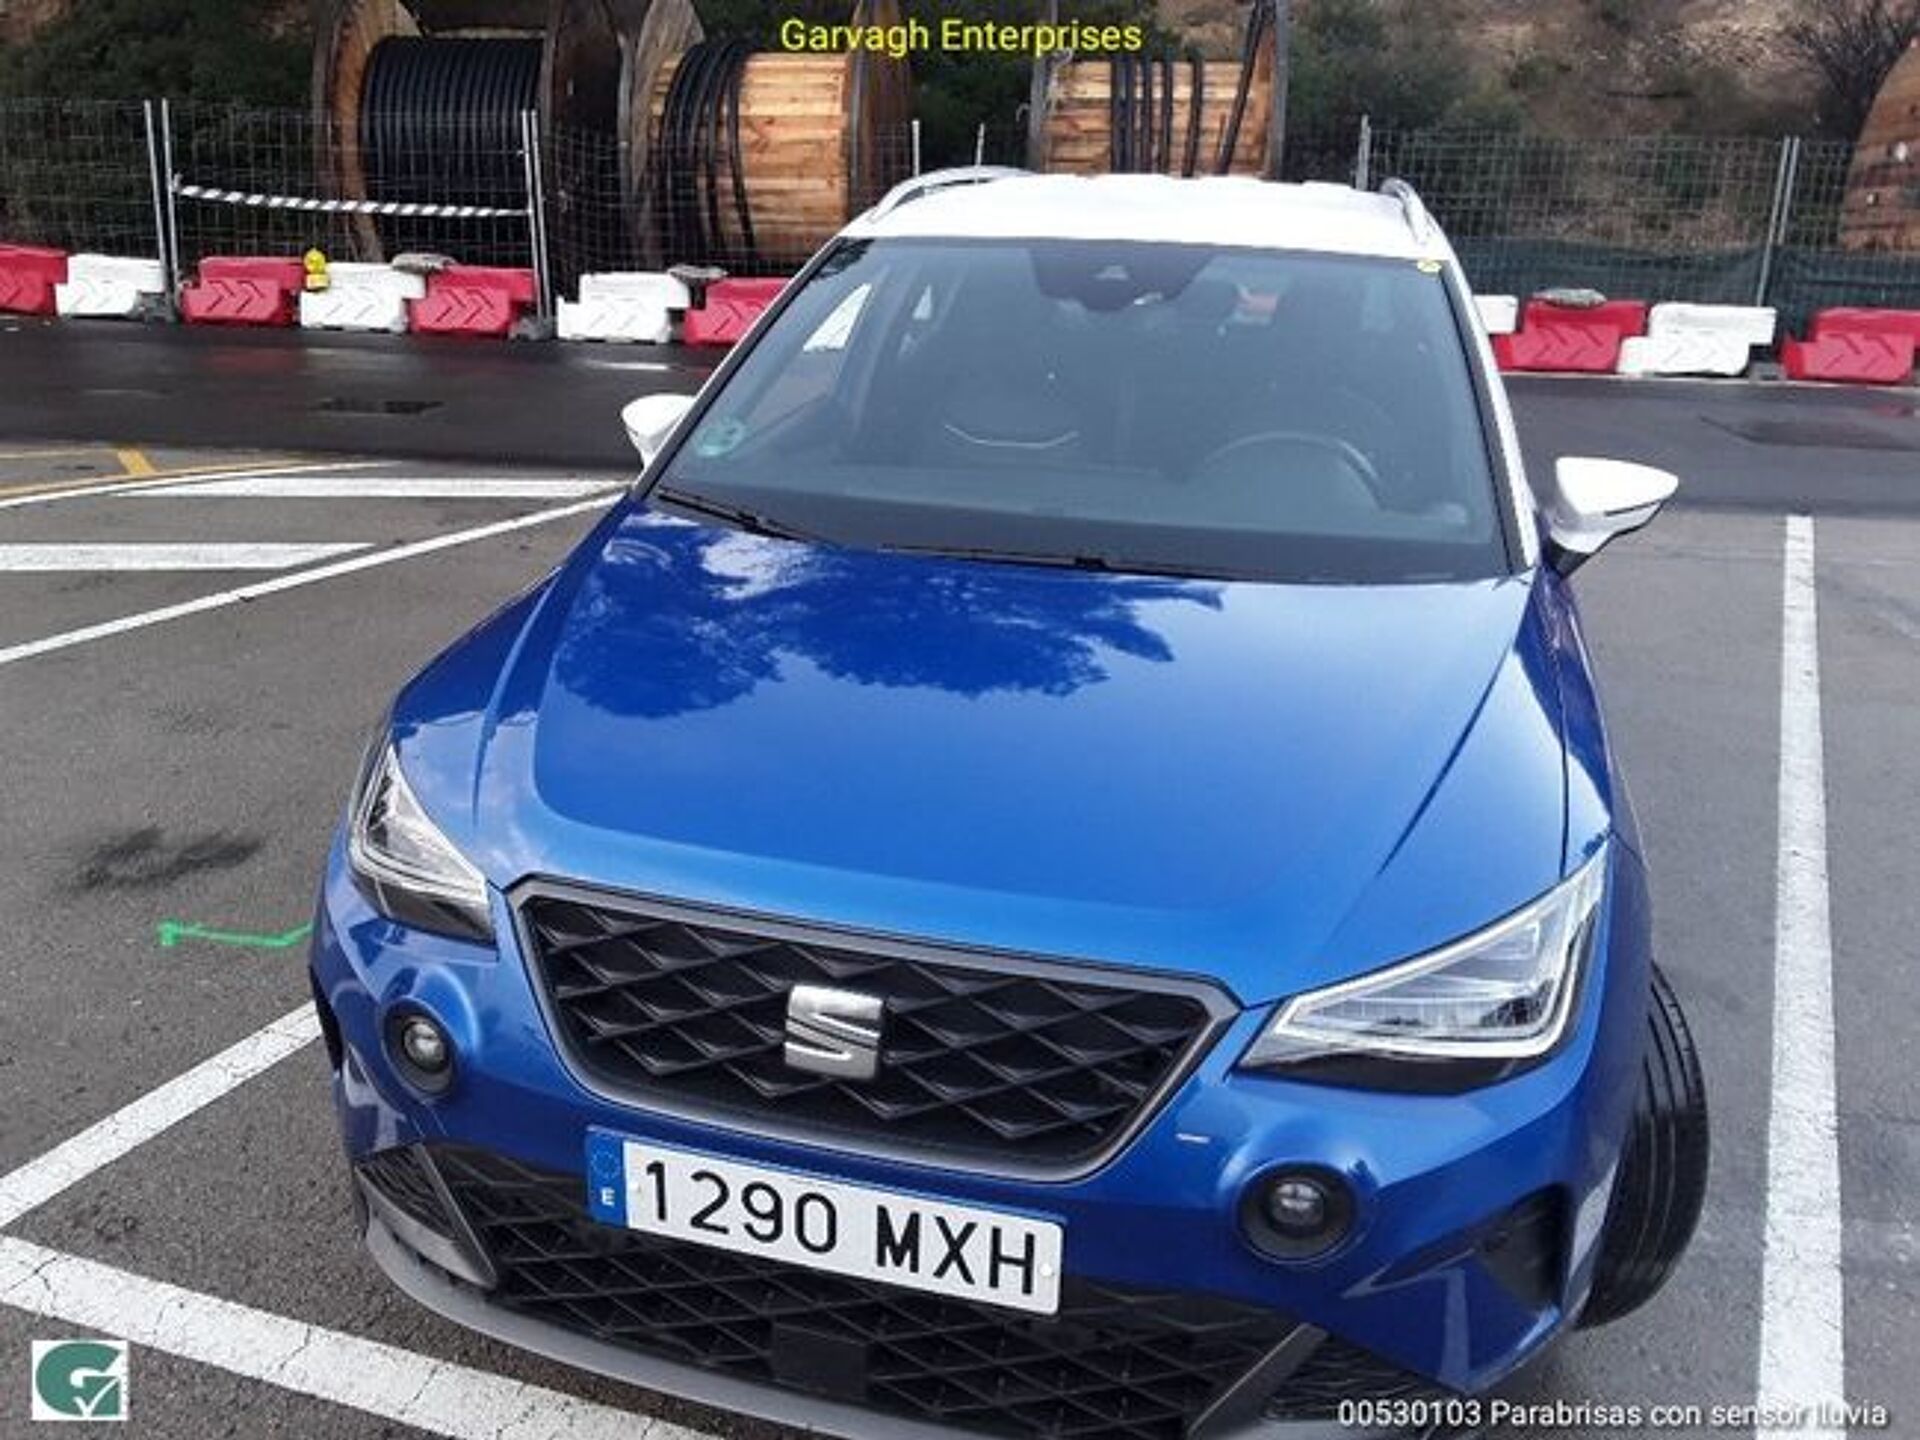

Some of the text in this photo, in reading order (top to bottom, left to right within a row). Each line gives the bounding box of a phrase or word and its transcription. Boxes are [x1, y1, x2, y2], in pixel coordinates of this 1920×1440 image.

[601, 1188, 615, 1207] E
[646, 1160, 1035, 1295] 1290 MXH
